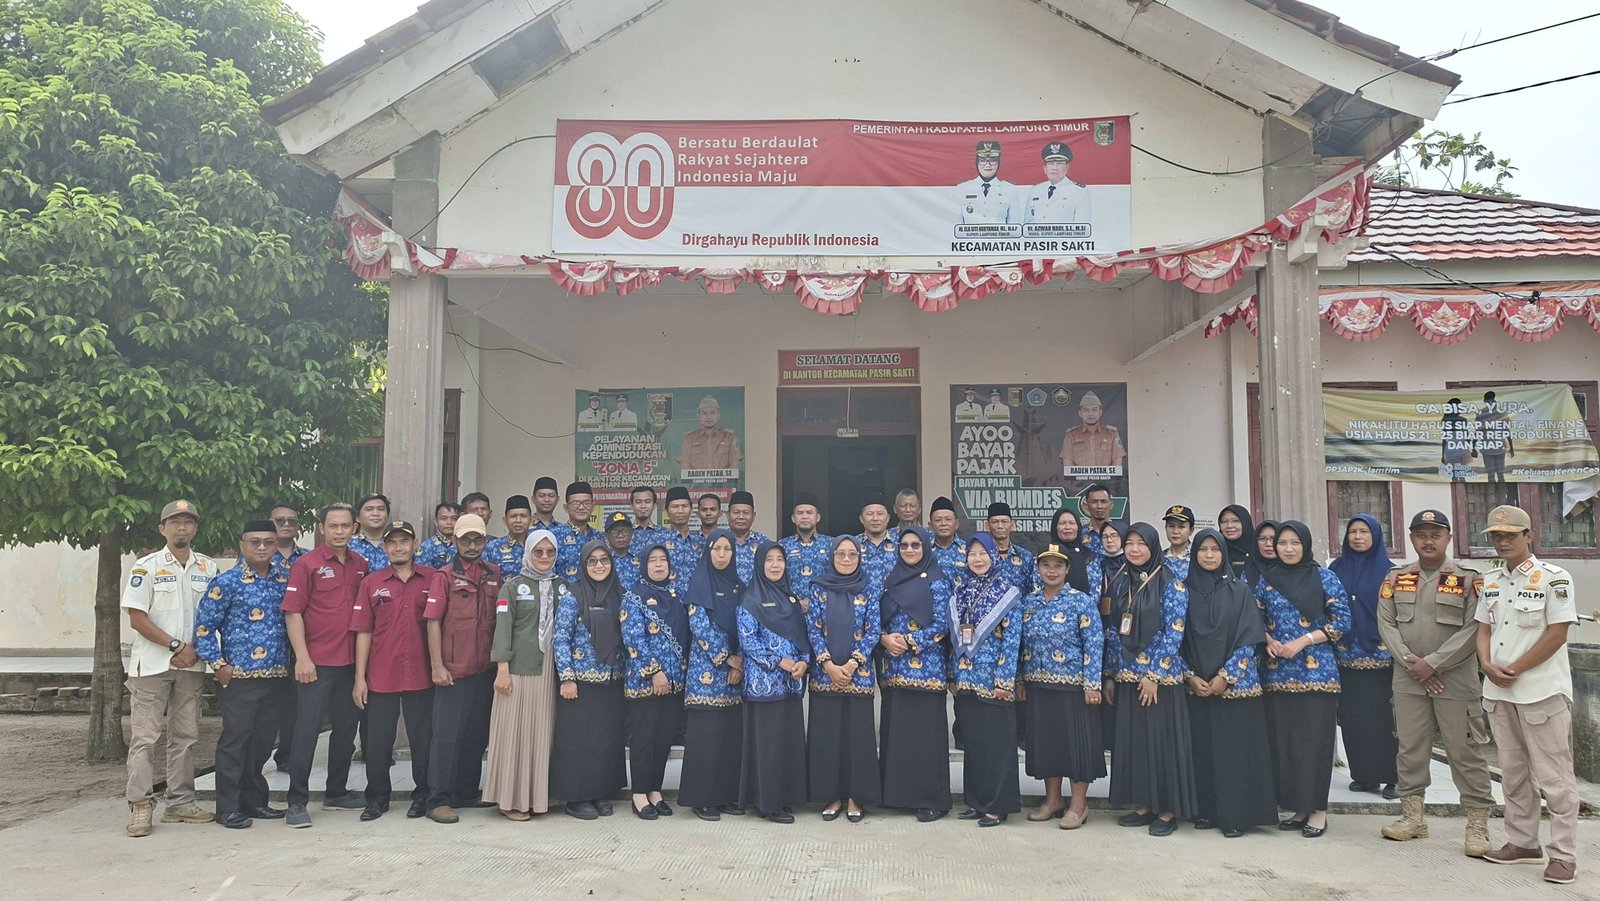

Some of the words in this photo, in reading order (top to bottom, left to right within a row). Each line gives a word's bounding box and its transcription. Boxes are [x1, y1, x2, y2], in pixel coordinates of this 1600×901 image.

[853, 124, 923, 134] PEMERINTAH
[1053, 122, 1090, 132] TIMUR
[678, 136, 737, 149] Bersatu
[742, 136, 818, 149] Berdaulat
[677, 153, 730, 167] Rakyat
[735, 152, 808, 167] Sejahtera
[677, 170, 753, 182] Indonesia
[758, 170, 797, 184] Maju
[565, 131, 675, 240] 80
[682, 233, 748, 249] Dirgahayu
[752, 233, 810, 248] Republik
[814, 233, 879, 247] Indonesia
[951, 242, 1020, 252] KECAMATAN
[1024, 241, 1058, 251] PASIR
[1061, 241, 1095, 251] SAKTI
[796, 355, 851, 366] SELAMAT
[854, 353, 900, 365] DATANG
[783, 371, 791, 380] DI
[792, 370, 822, 379] KANTOR
[823, 370, 868, 379] KECAMATAN
[869, 369, 891, 378] PASIR
[892, 368, 915, 377] SAKTI
[1415, 403, 1439, 414] GA
[1442, 403, 1482, 415] BISA,
[1485, 402, 1534, 413] YURA.
[1349, 421, 1386, 430] NIKAH
[1389, 421, 1408, 430] ITU
[1411, 421, 1453, 430] HARUS
[1455, 421, 1482, 430] SIAP
[594, 435, 656, 443] PELAYANAN
[960, 426, 1013, 441] AYOO
[1345, 430, 1373, 440] USIA
[1375, 430, 1416, 440] HARUS
[1418, 431, 1430, 440] 21
[1441, 431, 1454, 440] 25
[1456, 430, 1484, 440] BIAR
[1487, 430, 1563, 440] REPRODUKSI
[588, 443, 661, 452] ADMINISTRASI
[958, 442, 1015, 459] BAYAR
[1447, 441, 1473, 450] DAN
[1475, 441, 1505, 450] SIAP.
[582, 450, 667, 460] KEPENDUDUKAN
[957, 459, 1016, 475] PAJAK
[959, 478, 986, 488] BAYAR
[988, 478, 1014, 487] PAJAK
[964, 490, 991, 508] VIA
[1012, 520, 1034, 532] ASIR
[1438, 586, 1463, 594] POLPP
